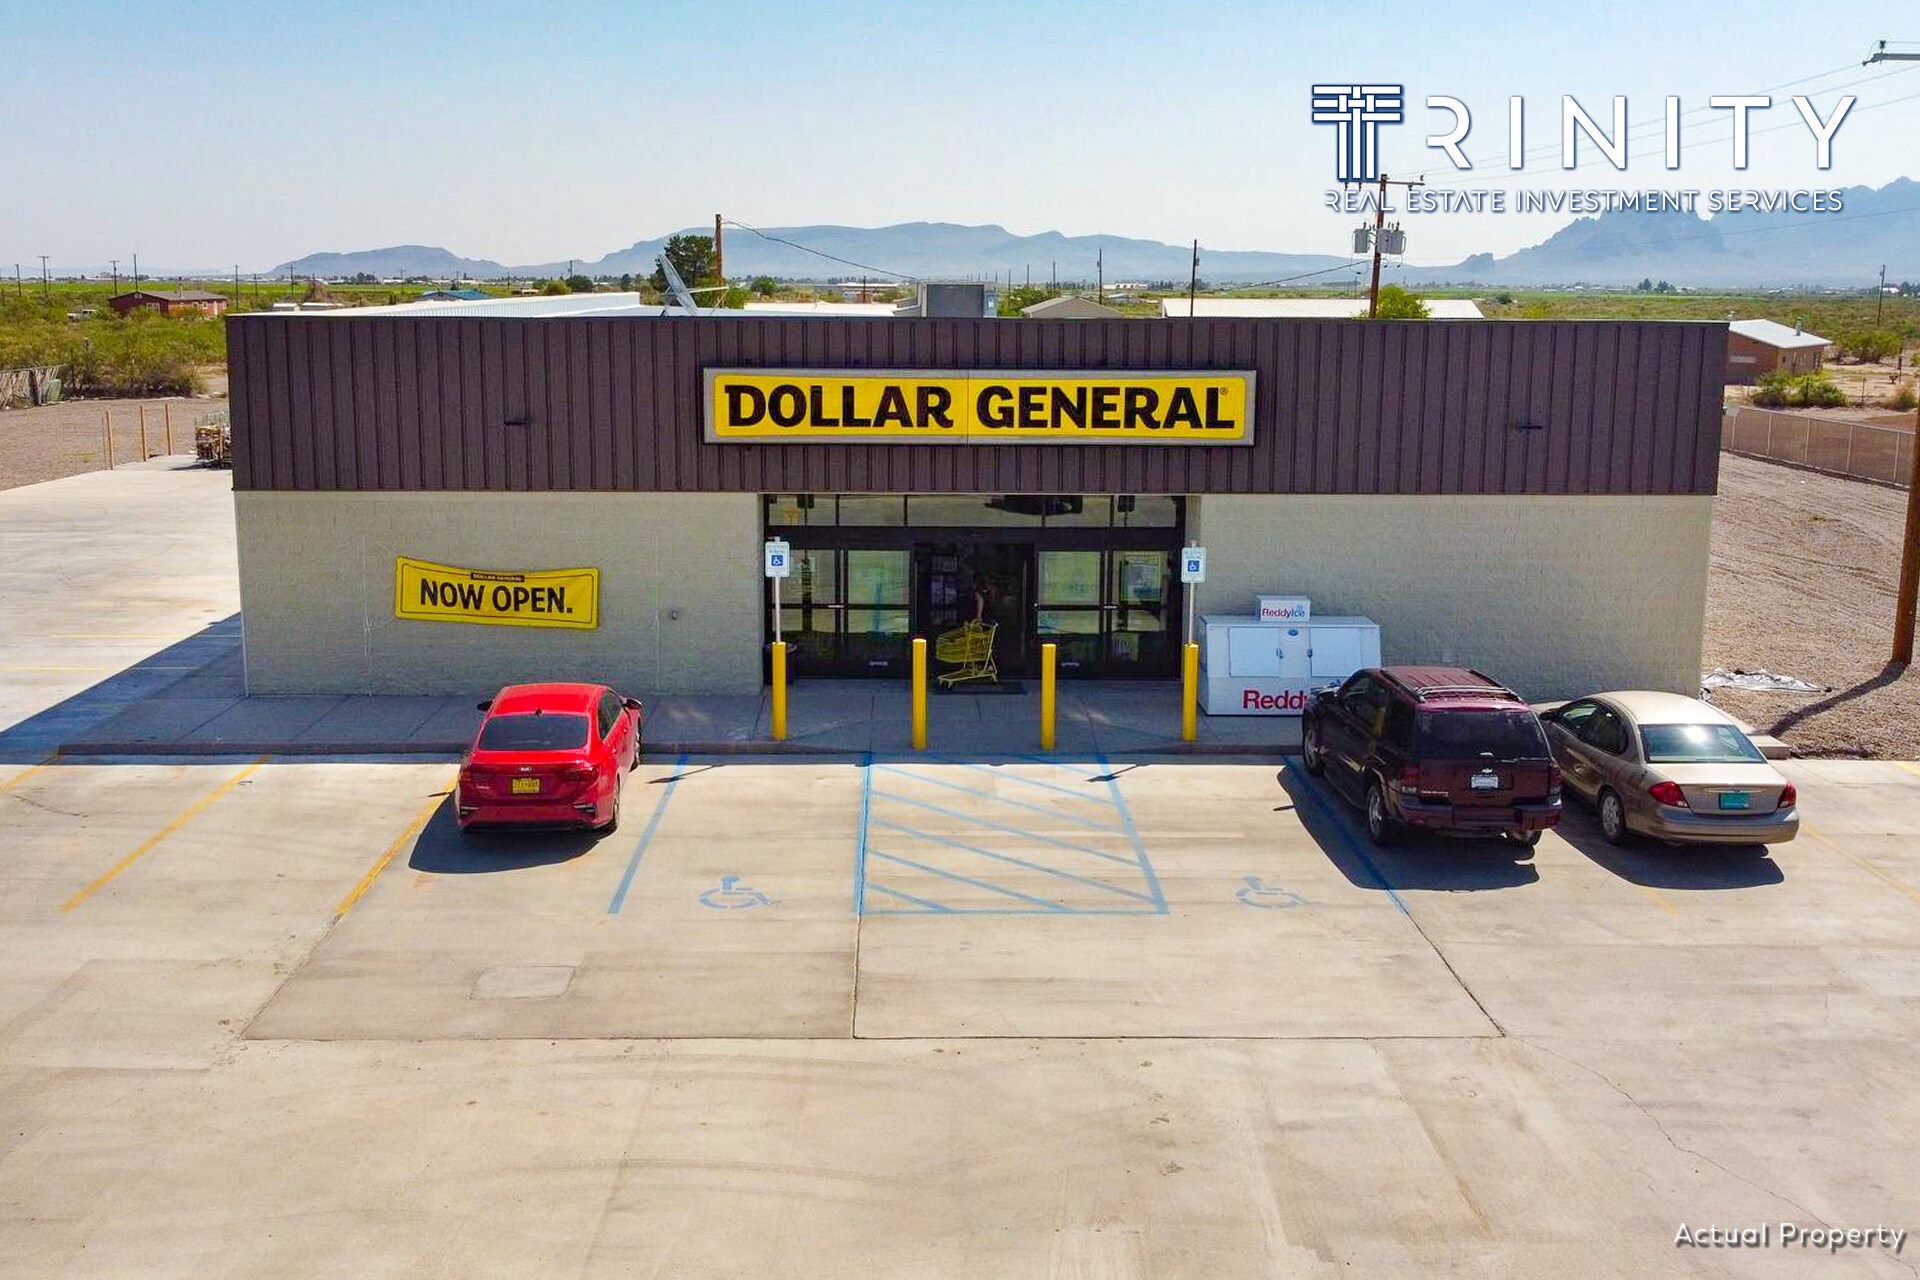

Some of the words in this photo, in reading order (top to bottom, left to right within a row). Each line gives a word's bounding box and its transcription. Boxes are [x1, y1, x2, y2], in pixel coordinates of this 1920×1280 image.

[725, 384, 954, 428] DOLLAR
[420, 578, 485, 610] NOW
[492, 585, 573, 614] OPEN.
[1243, 689, 1311, 710] Redd
